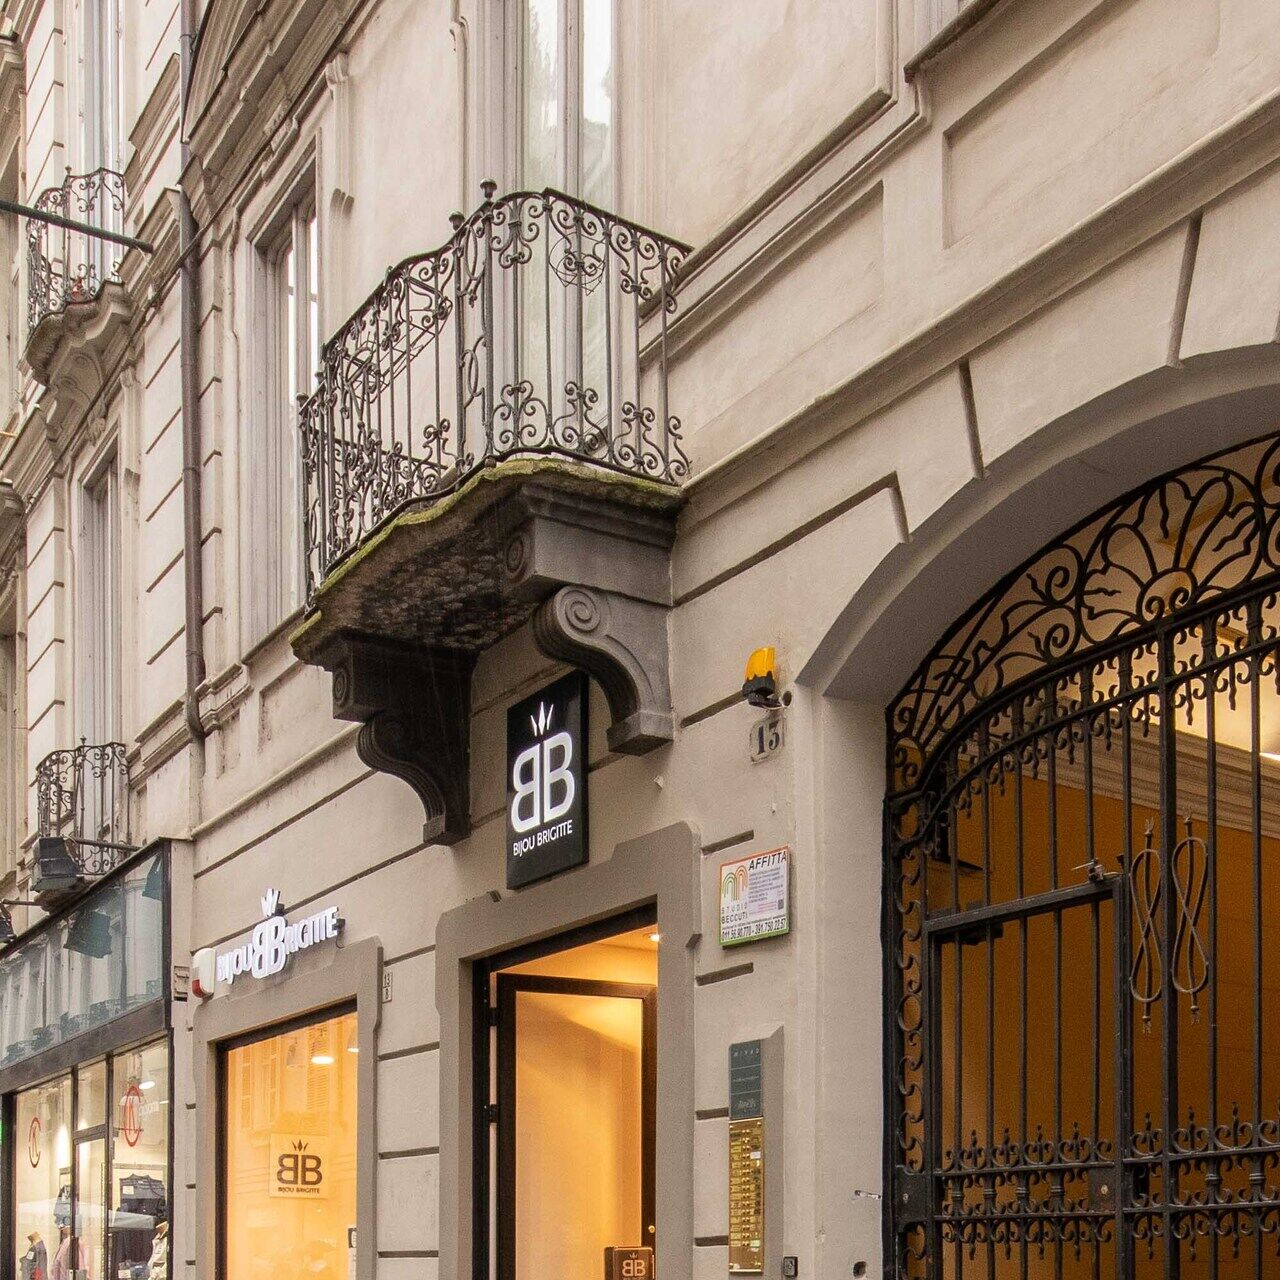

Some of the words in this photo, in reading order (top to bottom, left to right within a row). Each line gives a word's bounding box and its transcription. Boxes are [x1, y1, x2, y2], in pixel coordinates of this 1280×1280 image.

[757, 720, 780, 755] 13
[513, 835, 535, 857] BIJOU
[537, 820, 572, 846] BRIGITTE
[749, 851, 787, 871] AFFITTA
[217, 944, 253, 984] BIJOU
